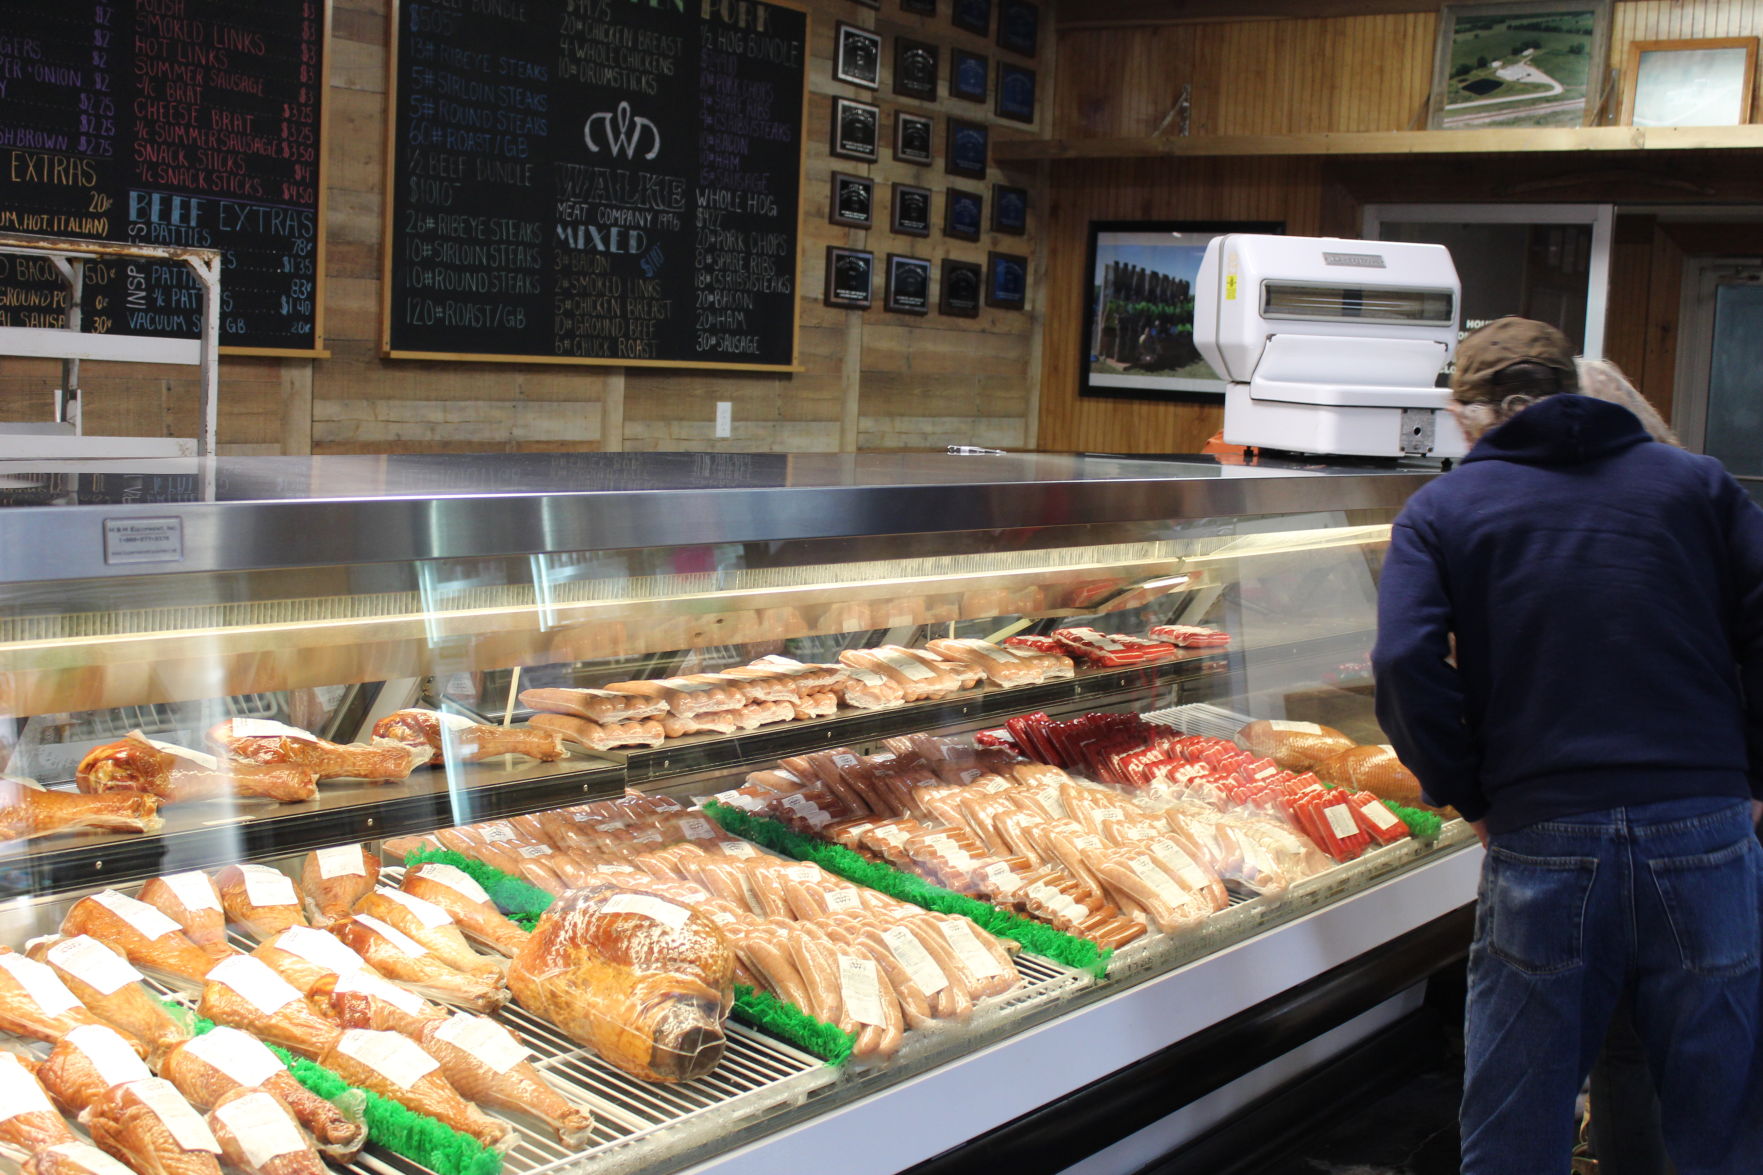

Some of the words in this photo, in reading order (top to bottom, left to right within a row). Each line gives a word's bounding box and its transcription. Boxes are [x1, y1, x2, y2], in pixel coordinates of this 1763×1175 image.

[135, 14, 205, 43] SMOKED
[212, 23, 266, 57] LINKS
[134, 34, 169, 57] HOT
[177, 44, 230, 70] LINKS
[34, 63, 80, 88] ONION
[133, 56, 205, 86] SUMMER
[208, 68, 266, 96] SAUSAGE
[498, 56, 550, 82] STEAKS
[166, 80, 203, 104] BRAT
[133, 97, 200, 126] CHEESE
[211, 108, 255, 134] BRAT
[154, 122, 217, 150] SUMMER
[11, 151, 97, 187] EXTRAS
[133, 141, 190, 168] SNACK
[196, 147, 248, 175] STICKS
[158, 164, 209, 191] SNACK
[211, 172, 265, 200] STICKS
[128, 189, 208, 228] BEEF
[218, 201, 314, 239] EXTRAS
[556, 199, 591, 222] MEAT
[597, 206, 653, 229] COMPANY
[695, 187, 743, 212] WHOLE
[747, 193, 778, 216] HOG
[151, 223, 212, 247] PATTIES
[488, 217, 544, 245] STEAKS
[553, 223, 648, 255] MIXED
[16, 257, 62, 284] BACO
[489, 244, 543, 270] STEAKS
[126, 265, 148, 309] INSP
[152, 265, 202, 288] PATTI
[489, 272, 543, 295] STEAKS
[0, 285, 50, 308] GROUND
[126, 311, 187, 332] VACUUM
[226, 317, 248, 334] GB
[716, 311, 747, 330] HAM
